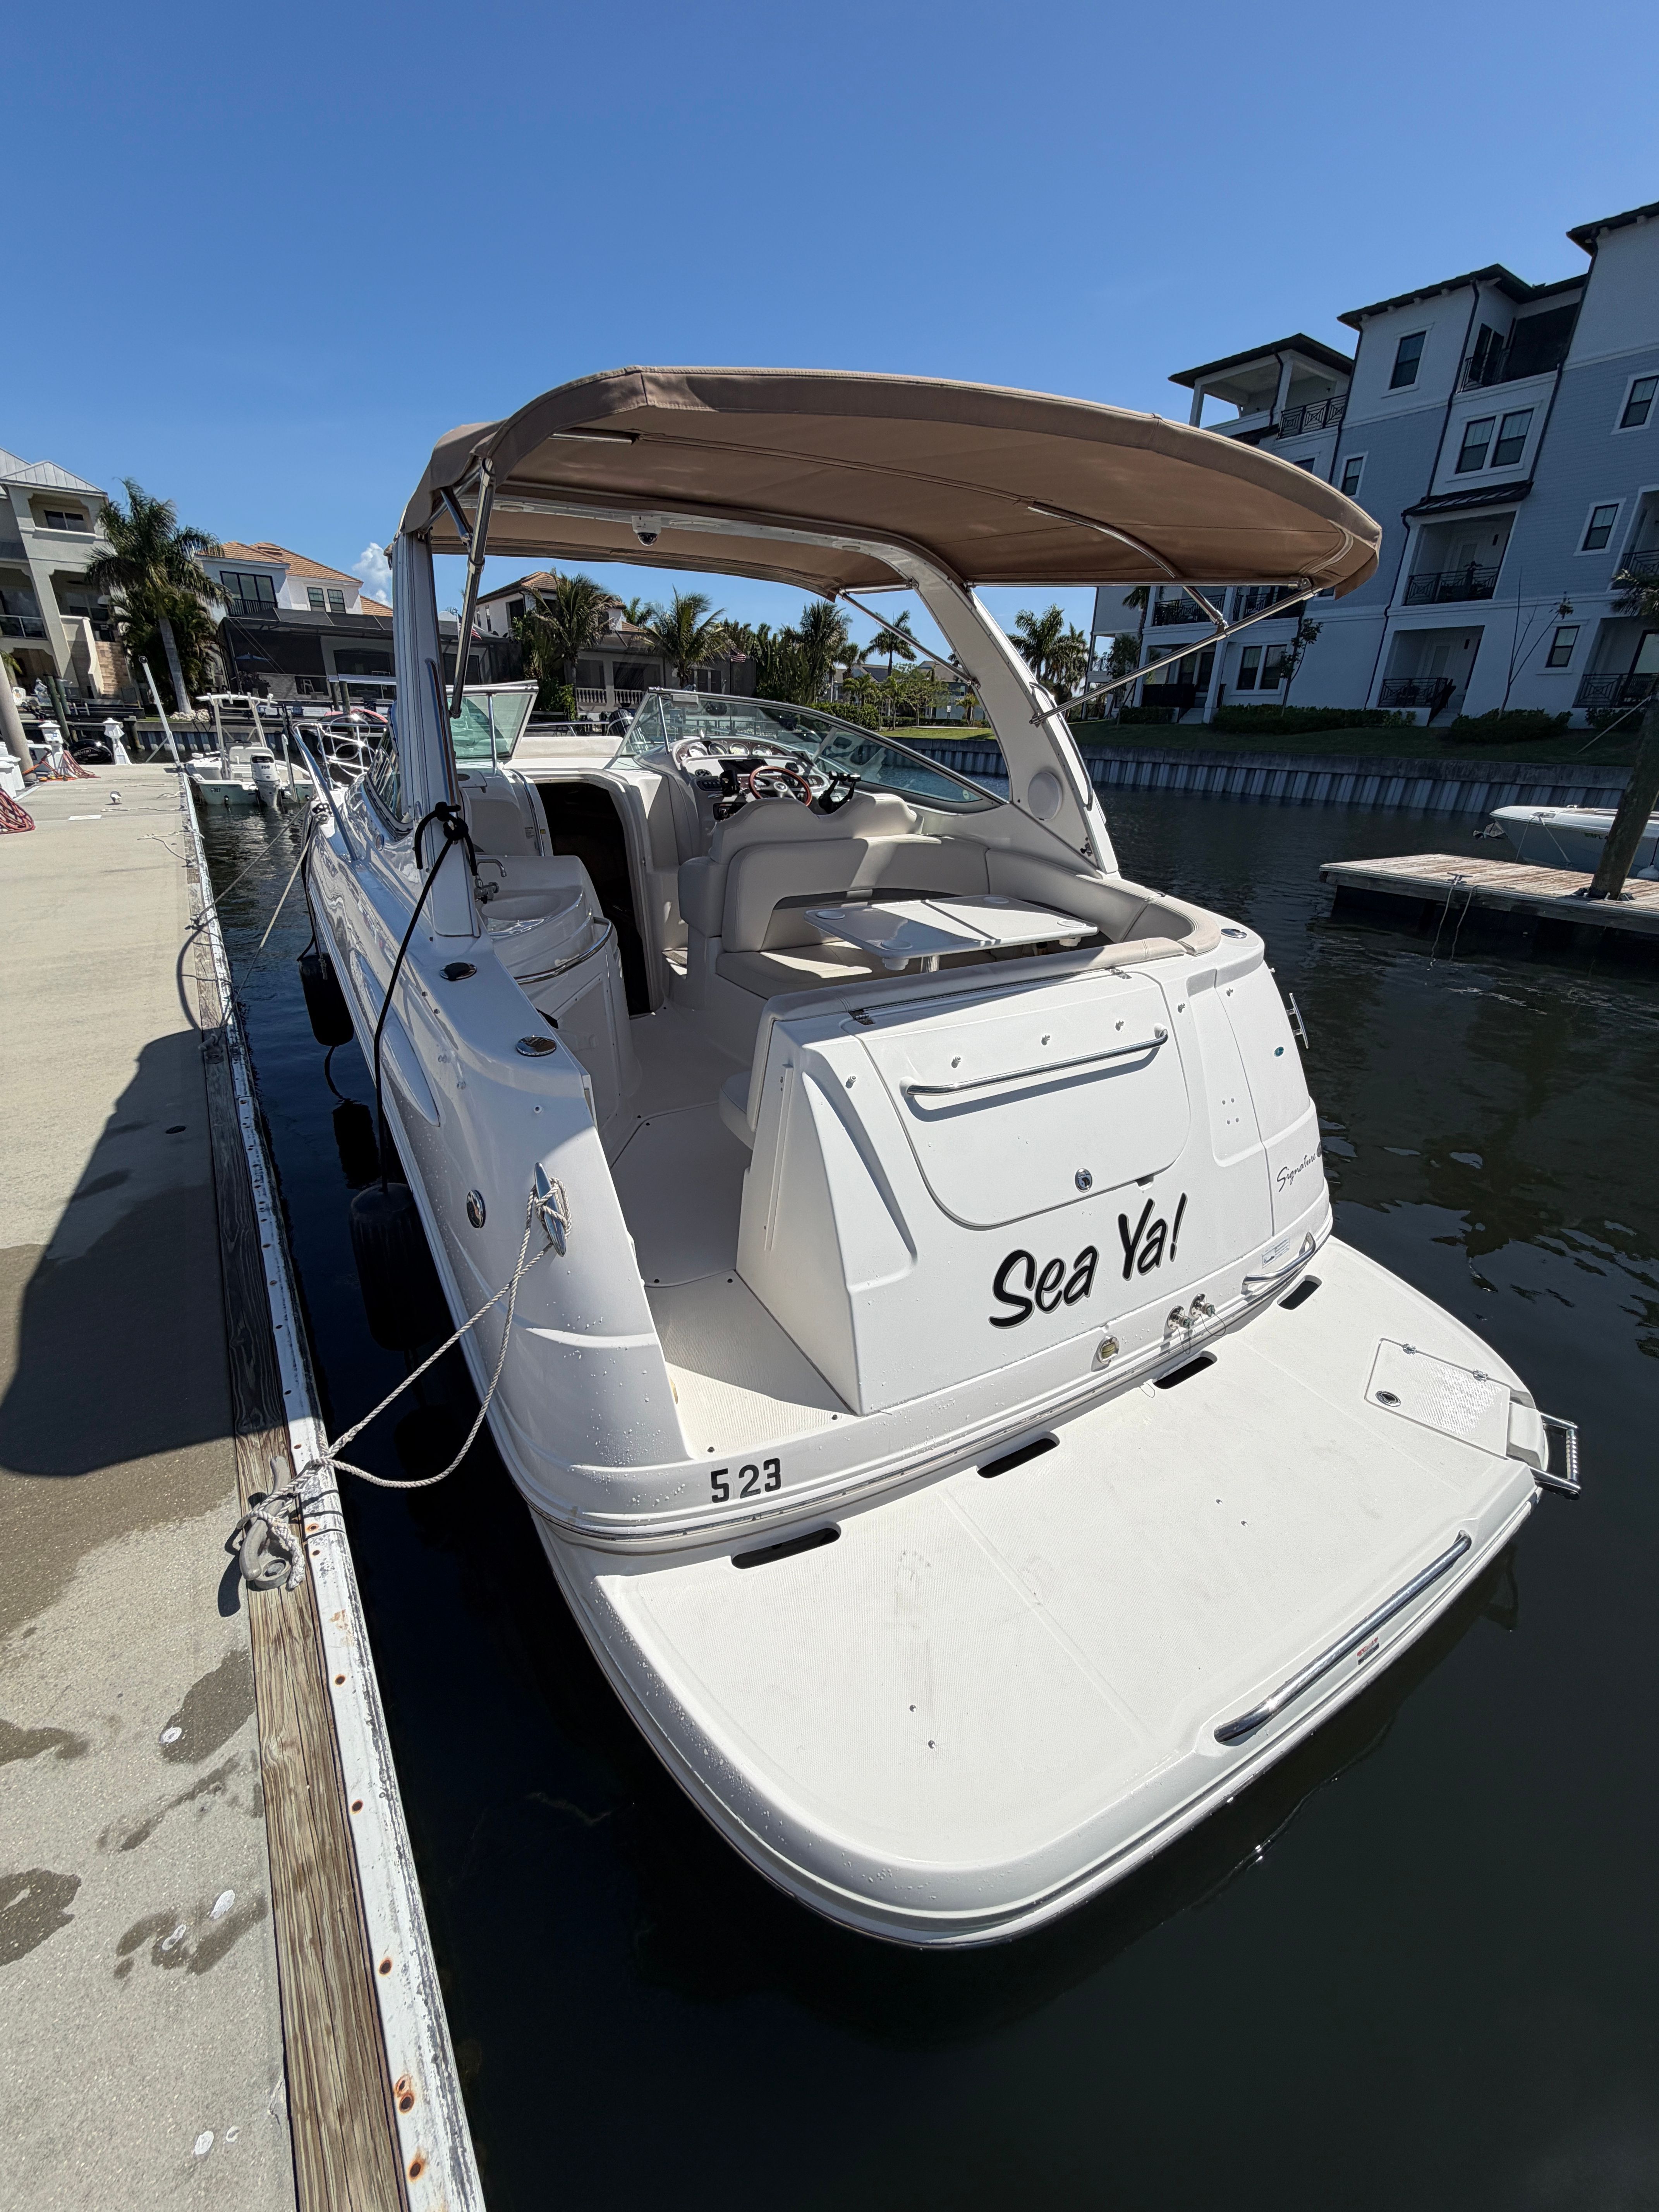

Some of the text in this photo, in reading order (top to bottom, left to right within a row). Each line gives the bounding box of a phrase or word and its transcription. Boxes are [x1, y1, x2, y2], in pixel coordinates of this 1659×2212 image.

[1277, 1153, 1316, 1192] Signature
[988, 1192, 1188, 1329] Sea Ya!
[711, 1458, 781, 1503] 523
